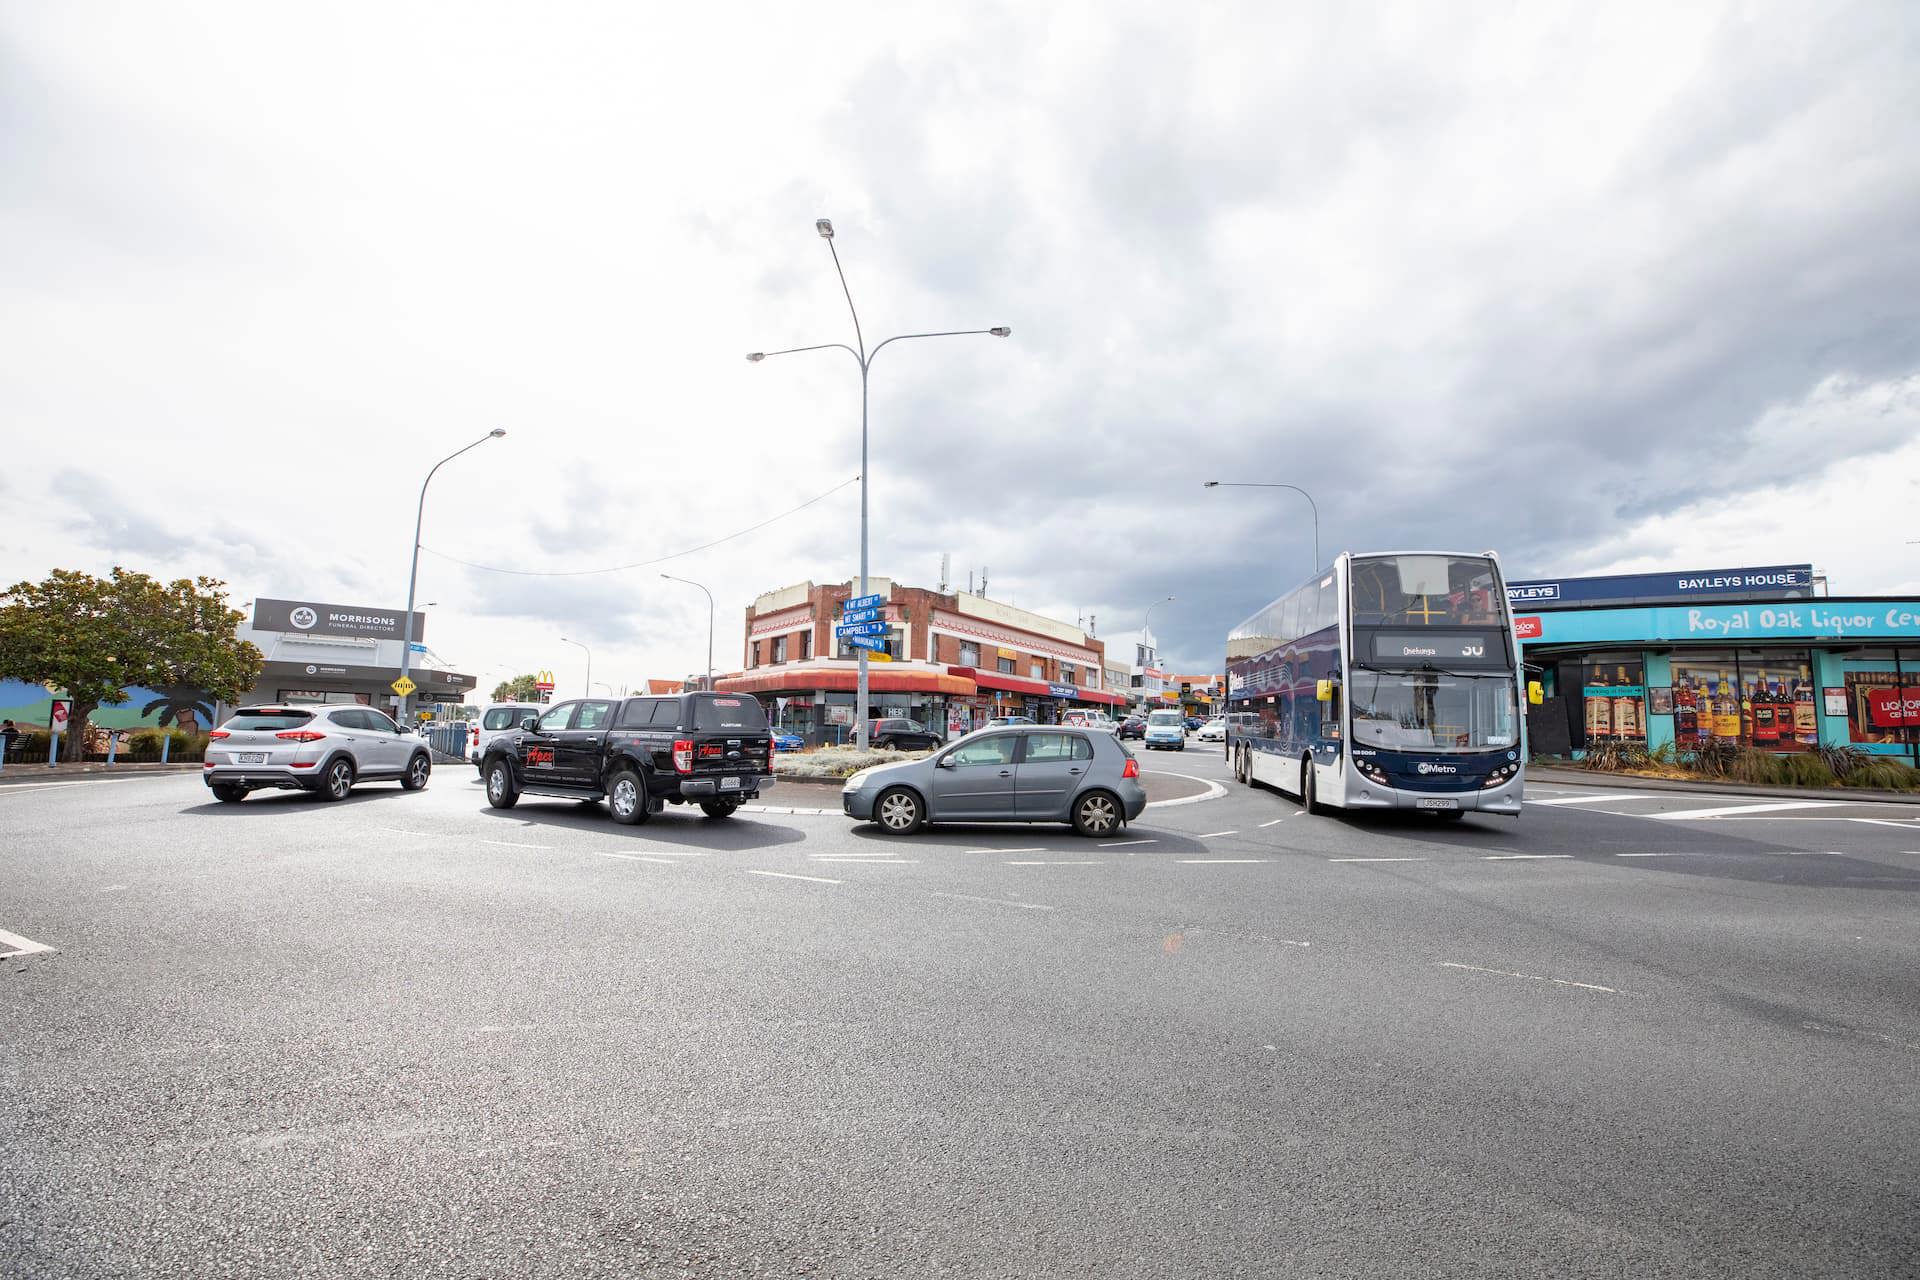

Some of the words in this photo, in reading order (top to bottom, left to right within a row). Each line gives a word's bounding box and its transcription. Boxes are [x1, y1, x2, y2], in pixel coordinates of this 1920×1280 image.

[1678, 577, 1742, 589] BAYLEYS
[1745, 573, 1796, 586] HOUSE
[1507, 588, 1554, 598] AYLEYS
[329, 613, 395, 625] MORRISONS
[1688, 609, 1750, 634] Royal
[1760, 609, 1802, 628] Oak
[1811, 609, 1875, 633] Liquor
[360, 624, 395, 632] DIRECTORS
[839, 625, 869, 636] CAMPBELL
[1429, 764, 1457, 773] Metro
